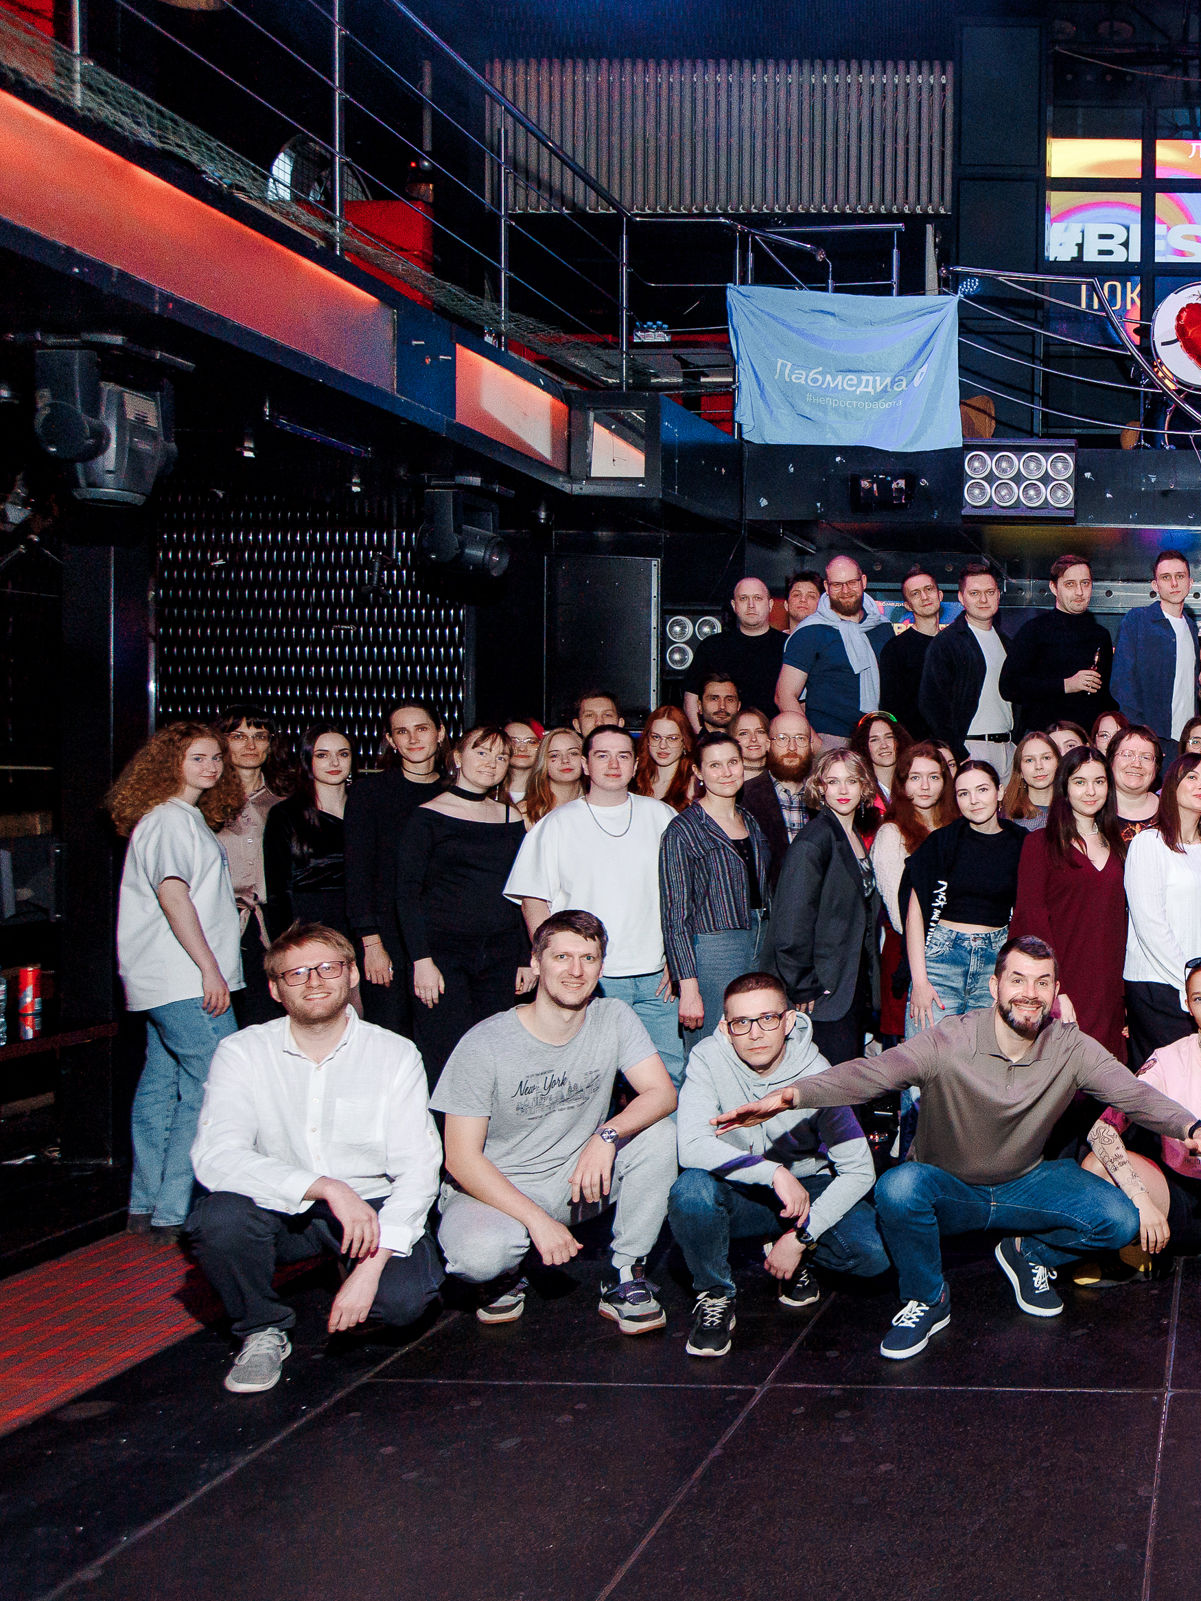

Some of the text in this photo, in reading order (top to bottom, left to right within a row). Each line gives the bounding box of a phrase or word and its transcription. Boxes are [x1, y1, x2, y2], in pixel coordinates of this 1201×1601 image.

[774, 358, 907, 395] Лабмедиа
[511, 1080, 538, 1098] New
[541, 1071, 568, 1096] York
